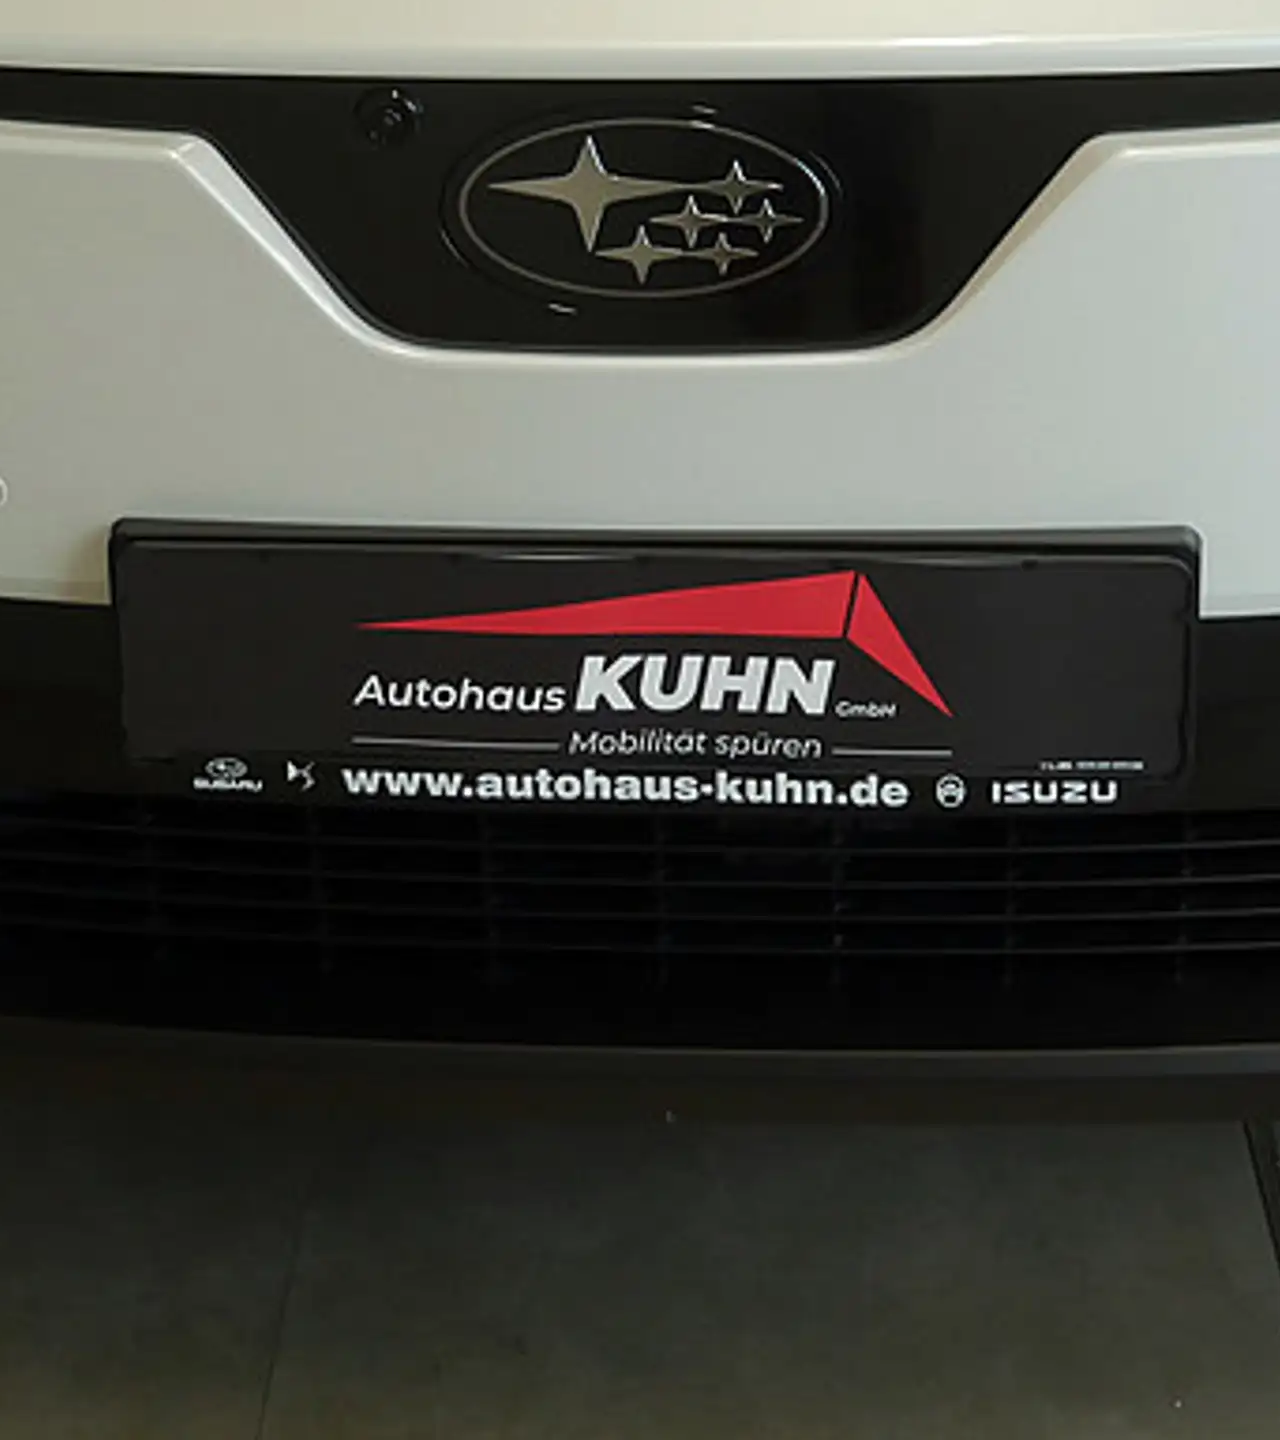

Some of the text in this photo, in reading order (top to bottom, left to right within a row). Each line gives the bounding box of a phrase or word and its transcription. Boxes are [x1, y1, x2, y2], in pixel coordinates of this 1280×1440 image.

[353, 654, 897, 718] Autohaus KUHN GmbH
[569, 727, 822, 759] Mobilität spüren
[340, 767, 911, 807] www.autohaus-kuhn.de
[990, 779, 1119, 806] ISUZU
